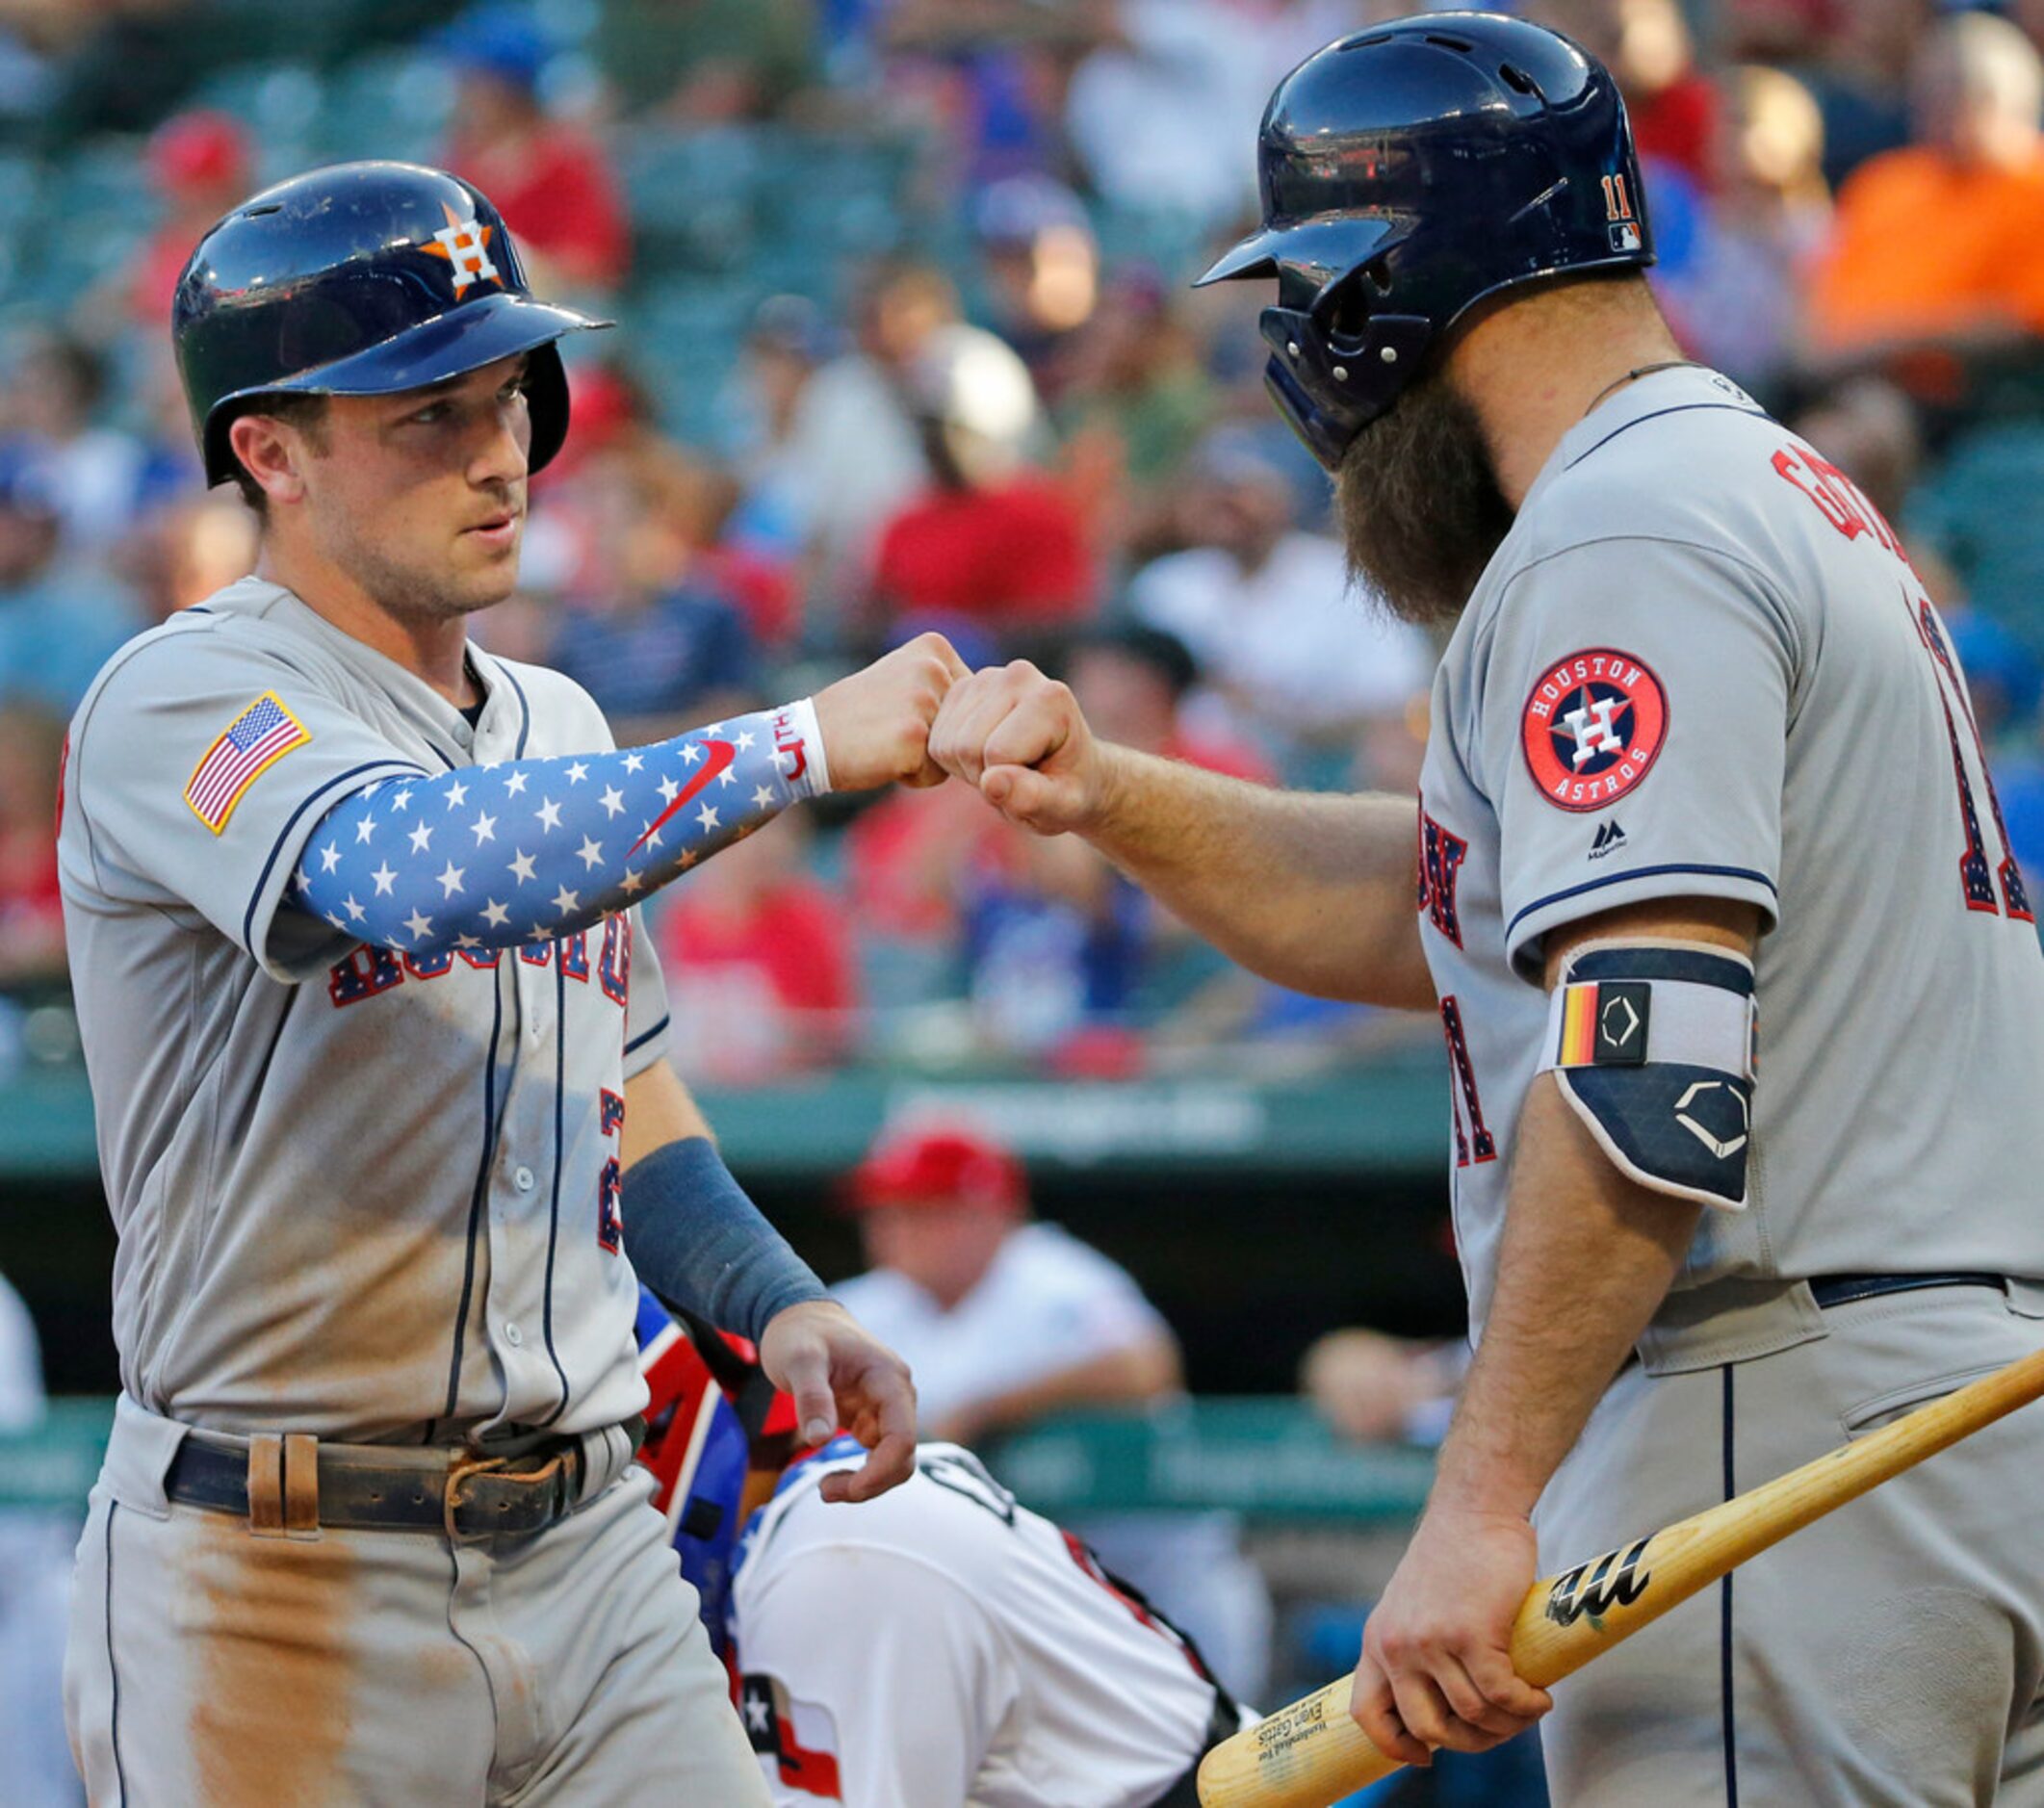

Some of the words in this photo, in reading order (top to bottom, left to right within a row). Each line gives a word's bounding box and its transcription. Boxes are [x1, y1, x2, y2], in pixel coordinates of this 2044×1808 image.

[1601, 174, 1631, 220] 11
[433, 220, 499, 288] H
[1532, 658, 1643, 717] HOUSTON
[1564, 697, 1622, 762] H
[1555, 748, 1647, 800] ASTROS
